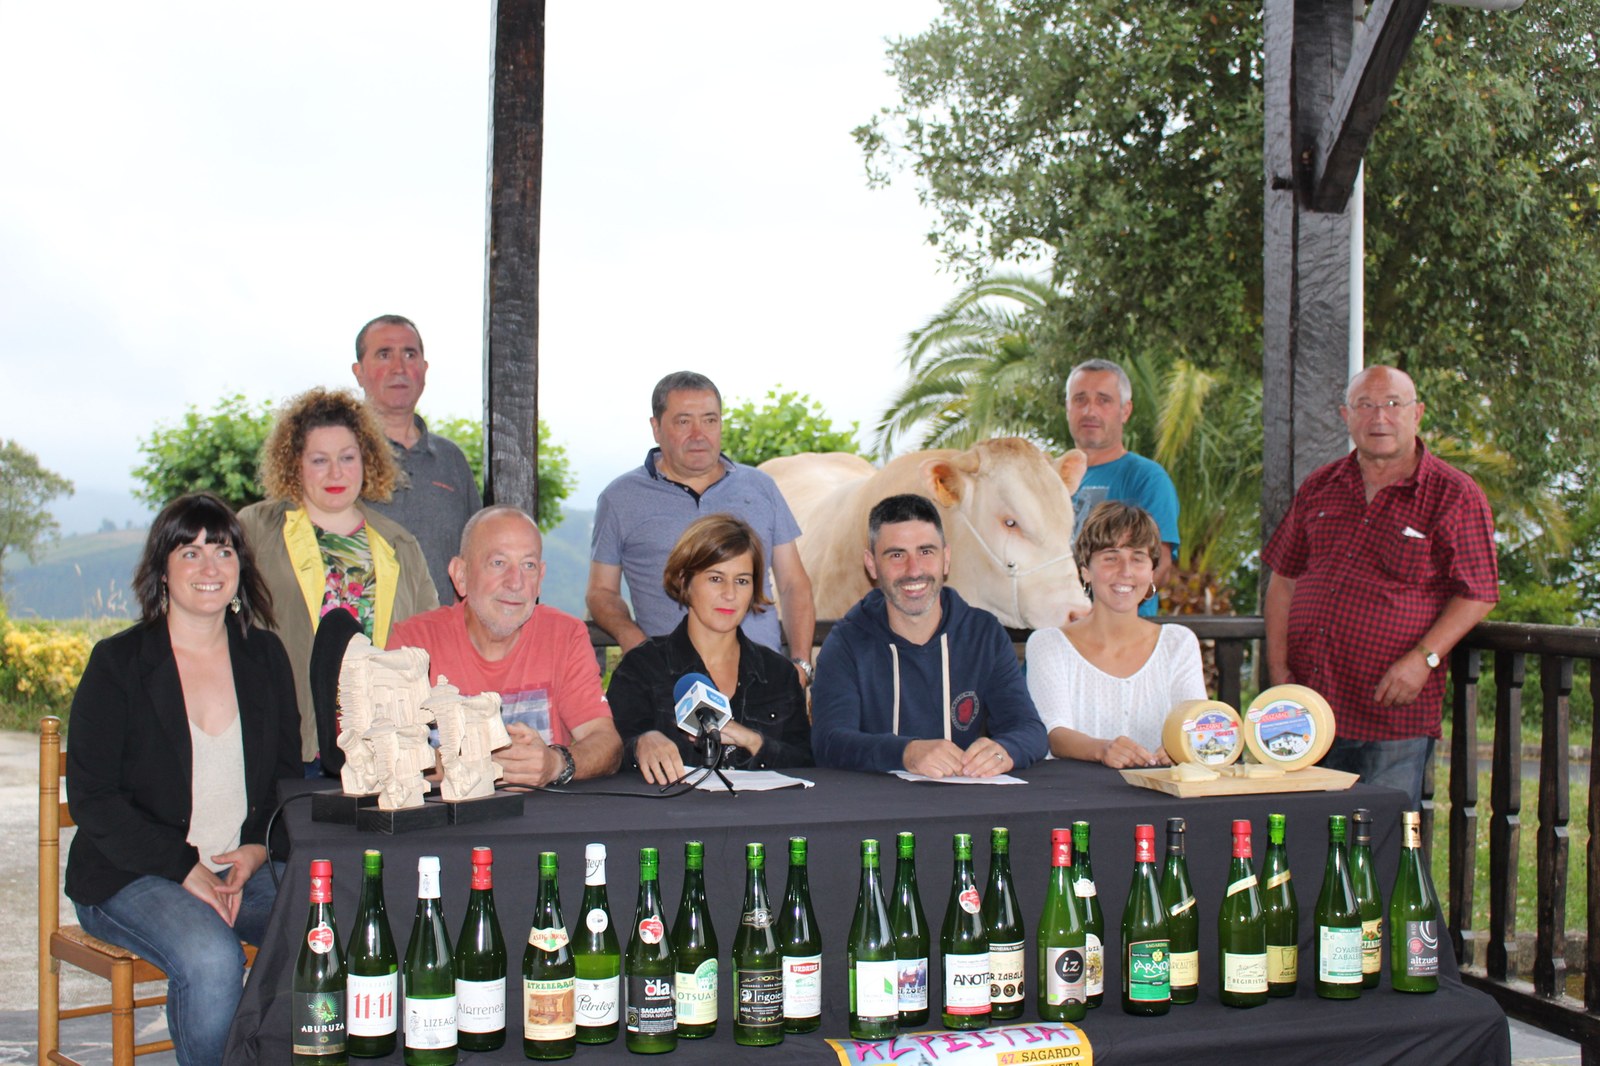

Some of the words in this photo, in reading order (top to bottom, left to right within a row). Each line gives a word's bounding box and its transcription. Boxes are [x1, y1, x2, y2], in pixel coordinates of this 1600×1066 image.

[1062, 957, 1080, 972] iz
[353, 990, 393, 1019] 11:11
[301, 1022, 345, 1033] ABURUZA
[1021, 1046, 1081, 1064] SAGARDO
